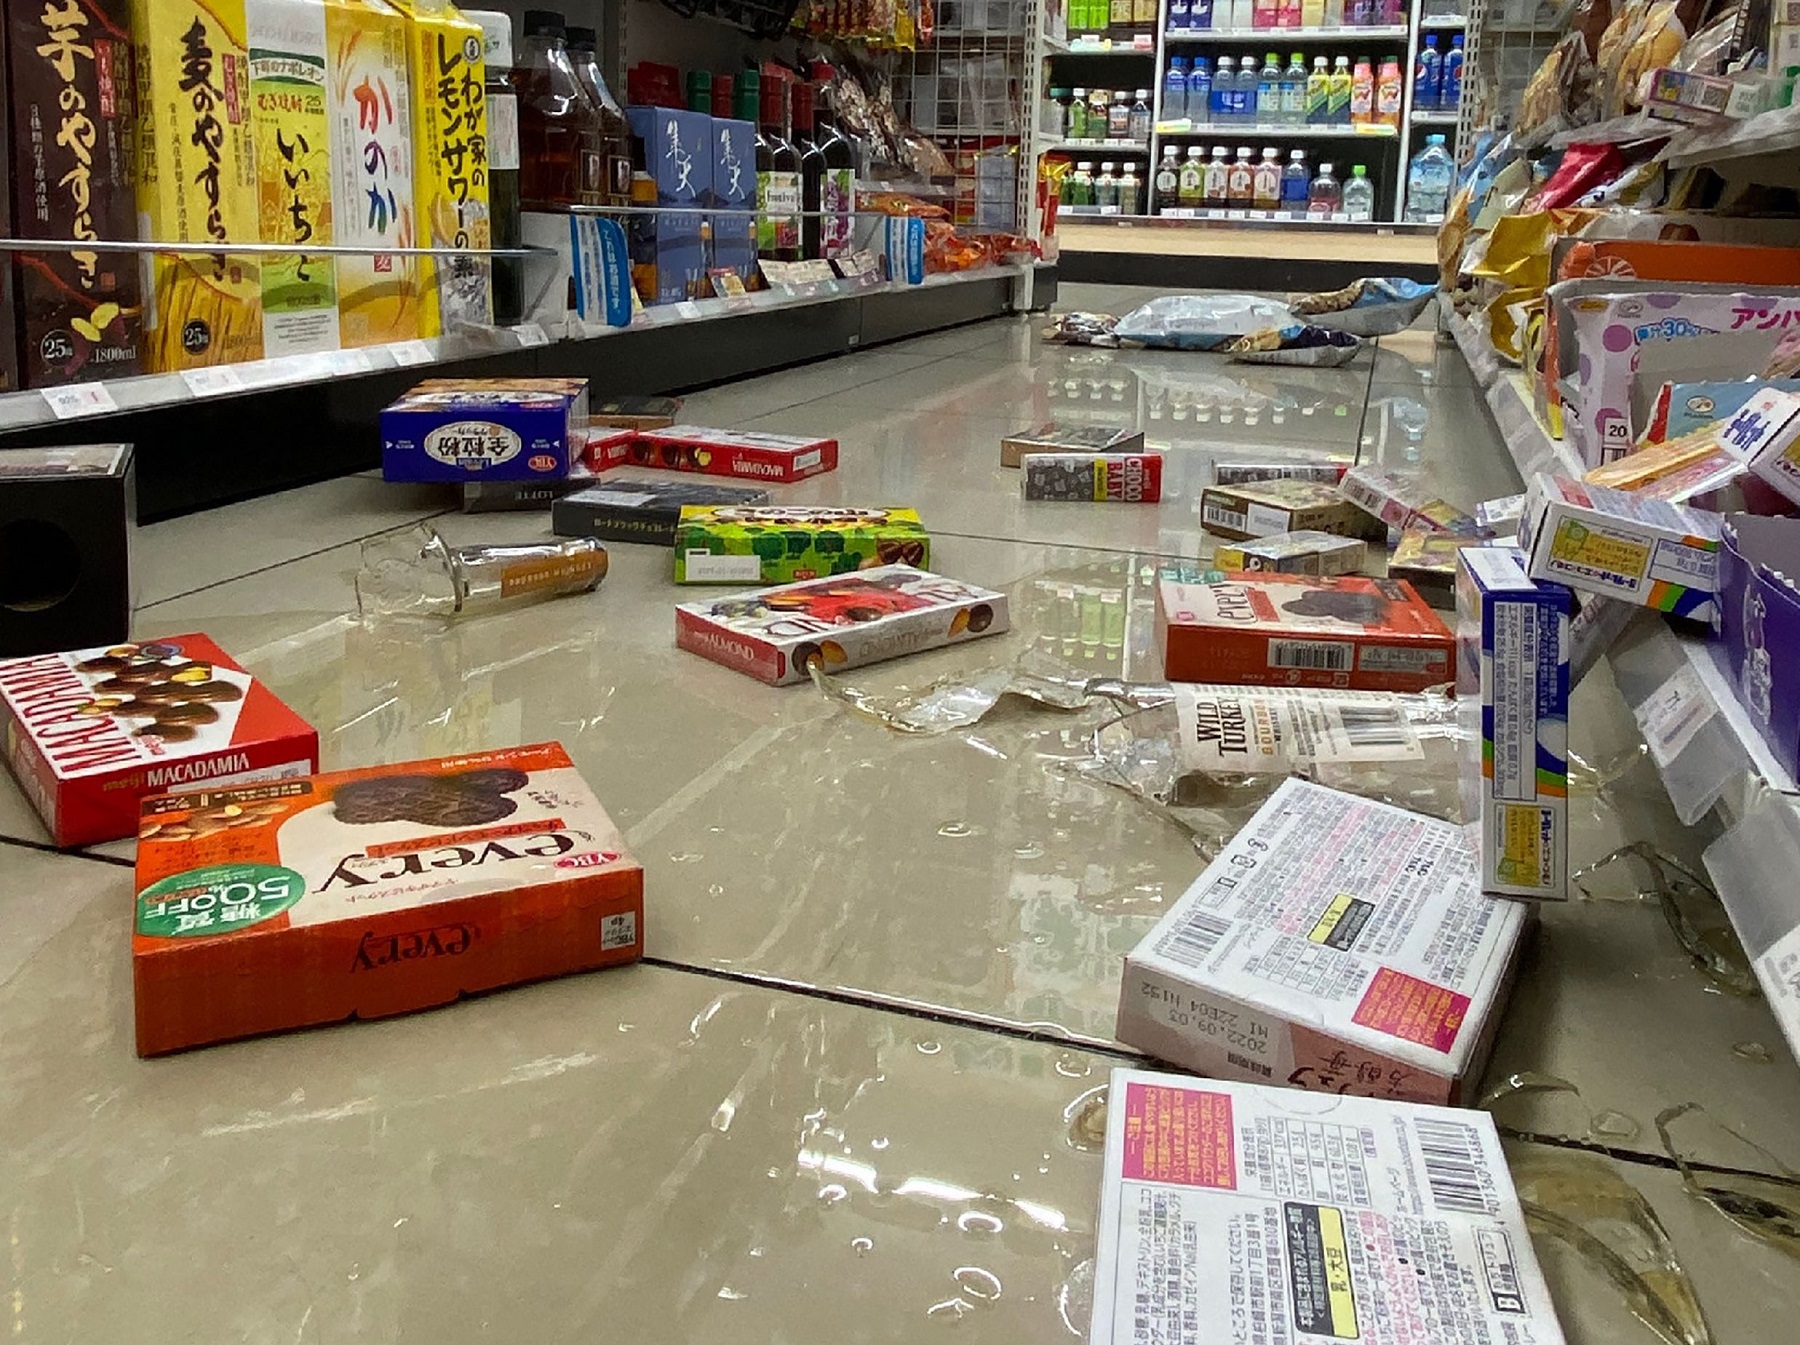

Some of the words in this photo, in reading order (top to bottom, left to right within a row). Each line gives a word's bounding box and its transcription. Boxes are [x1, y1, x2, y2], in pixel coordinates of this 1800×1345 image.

[251, 58, 325, 82] 下町のナポレオン
[37, 0, 99, 289] 芋のやすらぎ
[178, 15, 229, 281] 麦のやすらぎ
[460, 67, 487, 188] わが家の
[353, 75, 398, 236] かのか
[277, 127, 312, 282] いいちこ
[94, 345, 137, 364] 1800ml
[437, 435, 511, 457] 全粒粉
[1609, 424, 1627, 438] 20
[731, 459, 784, 478] MACADAMIA
[1107, 461, 1124, 501] BABY
[1125, 458, 1142, 502] CHOCO
[1197, 701, 1222, 743] WILD
[1217, 695, 1249, 759] TURKEY
[147, 752, 250, 788] MACADAMIA
[311, 832, 577, 895] every
[564, 853, 613, 868] YBC
[144, 893, 218, 919] OFF
[350, 923, 482, 974] every
[1168, 1007, 1267, 1056] 2022.09.03
[1326, 1247, 1348, 1293] 乳・大豆
